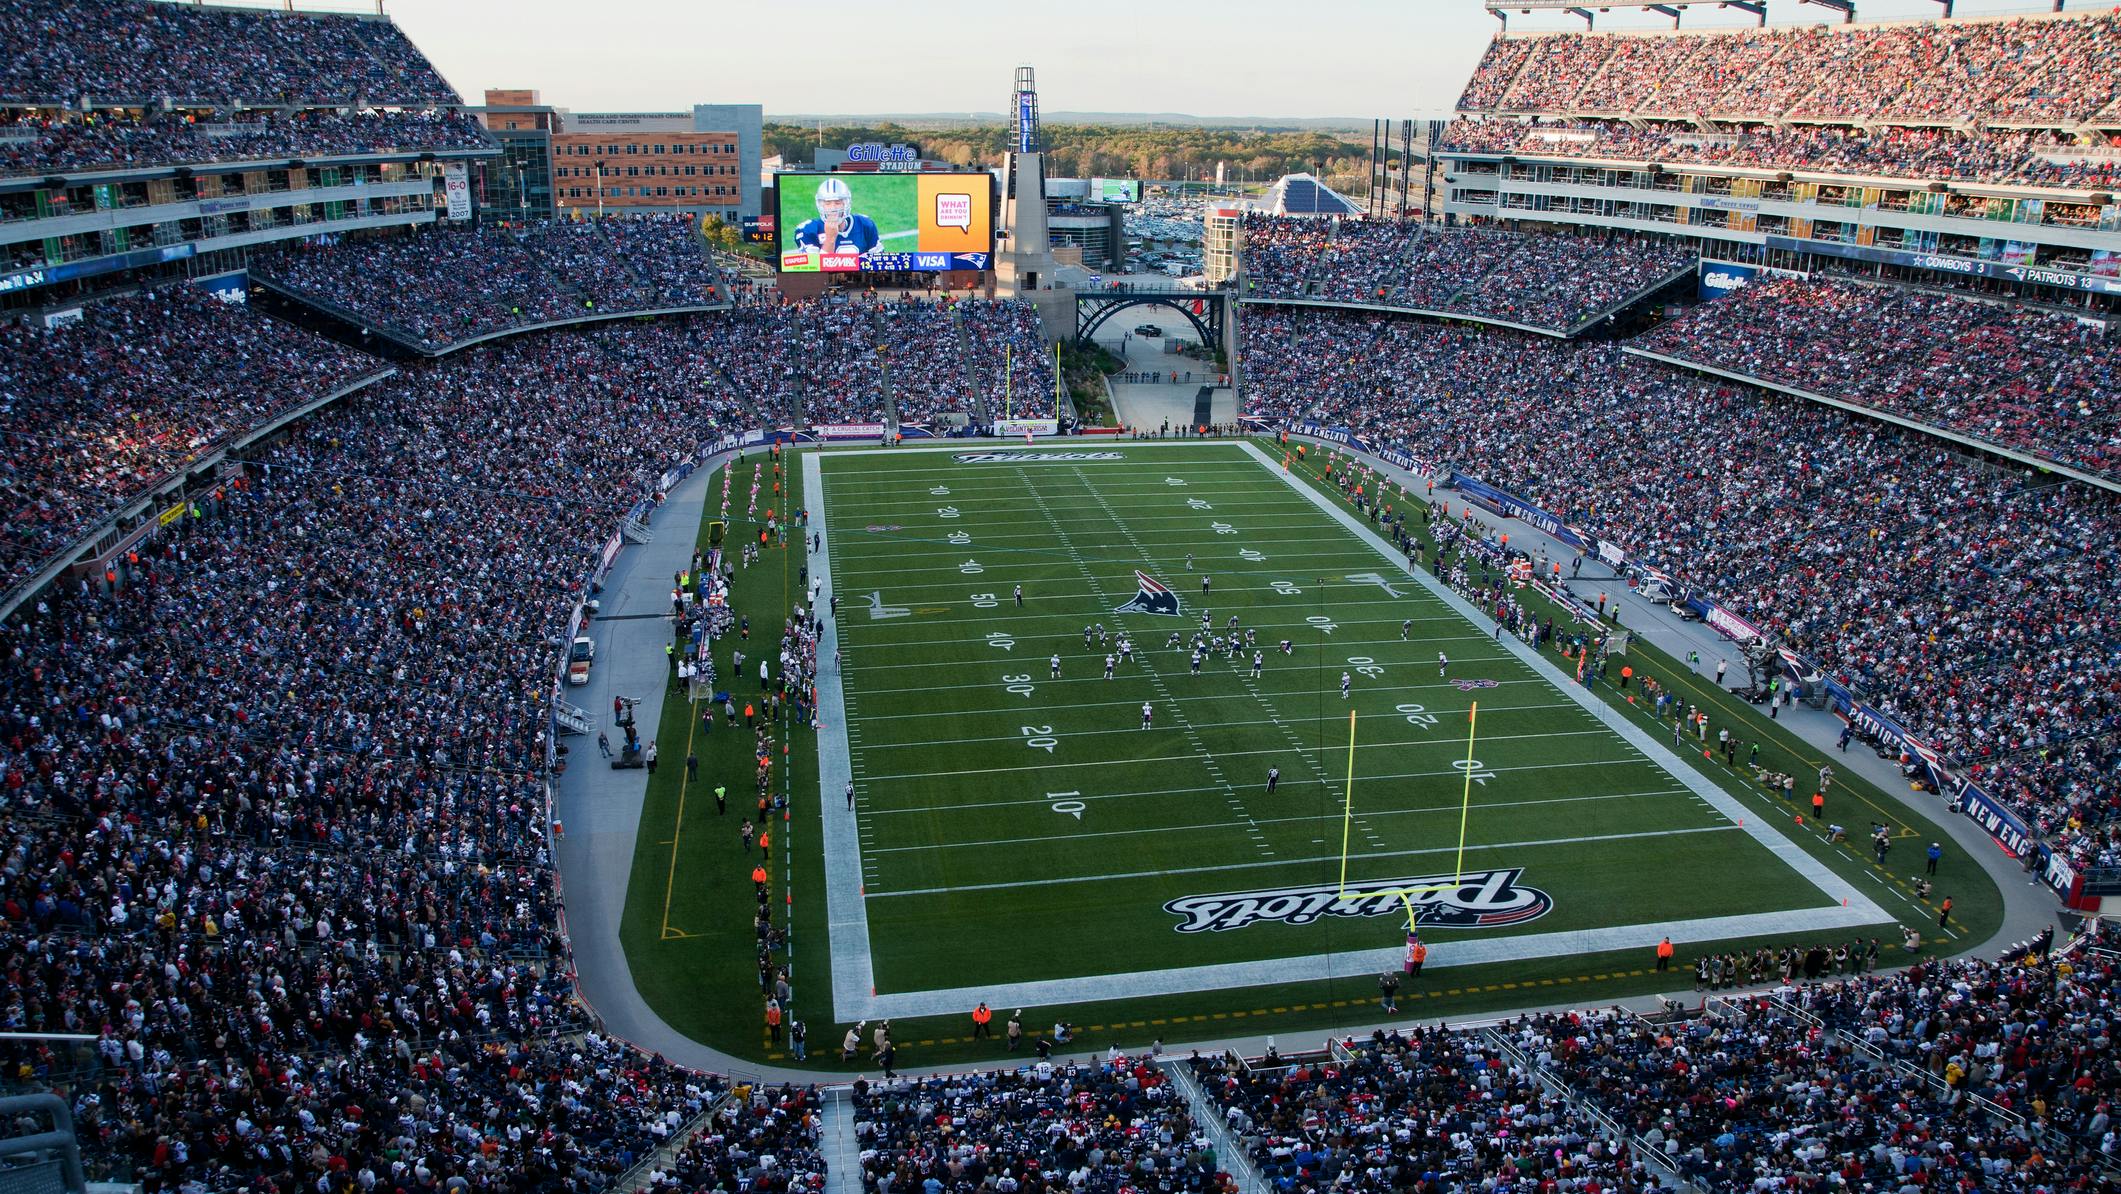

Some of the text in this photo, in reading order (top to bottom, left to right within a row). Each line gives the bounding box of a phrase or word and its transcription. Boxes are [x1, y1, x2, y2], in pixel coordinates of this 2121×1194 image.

[848, 143, 917, 162] Gillette
[880, 162, 922, 170] STADIUM
[940, 200, 968, 208] WHAT
[822, 256, 857, 268] RE/MAX
[917, 256, 946, 267] VISA
[1925, 256, 1971, 272] COWBOYS
[1977, 263, 1985, 274] 3
[2027, 269, 2076, 287] PATRIOTS
[2080, 277, 2093, 288] 13
[1290, 423, 1349, 443] NEW ENGLAND
[1382, 452, 1419, 469] PATRIOTS
[929, 486, 950, 495] 10
[937, 506, 960, 518] 20
[1186, 498, 1213, 510] 20
[1211, 522, 1238, 535] 30
[1521, 509, 1558, 534] ENGLAND
[947, 531, 971, 544] 30
[1239, 549, 1267, 562] 40
[958, 561, 984, 574] 40
[1270, 581, 1302, 595] 50
[970, 593, 998, 608] 50
[1305, 616, 1339, 632] 40
[986, 631, 1015, 647] 40
[1347, 656, 1384, 674] 30
[1002, 674, 1035, 693] 30
[1395, 704, 1439, 725] 20
[1021, 725, 1058, 748] 20
[1848, 707, 1907, 754] PATRIOTS
[1451, 759, 1496, 779] 10
[1046, 790, 1086, 813] 10
[1967, 798, 2001, 832] NEW
[1163, 868, 1552, 932] Patriots
[1041, 1066, 1049, 1074] 12
